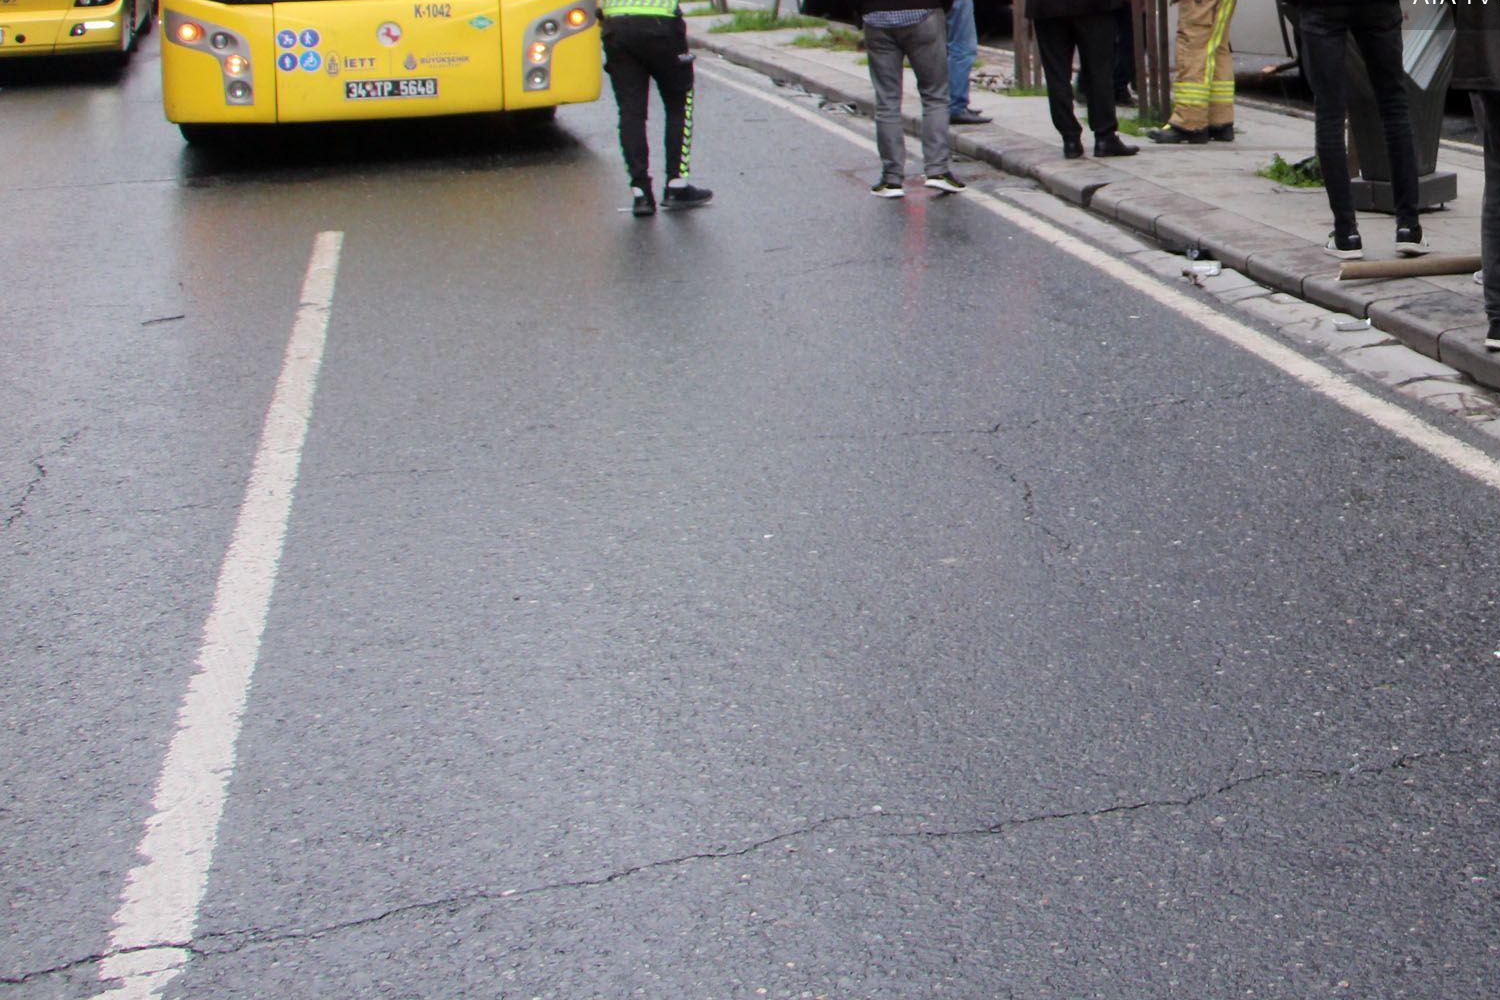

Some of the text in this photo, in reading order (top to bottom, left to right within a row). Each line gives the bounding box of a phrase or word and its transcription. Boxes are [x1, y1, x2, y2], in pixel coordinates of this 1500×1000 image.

[414, 4, 452, 18] K-1042
[343, 56, 376, 69] İETT
[348, 81, 367, 98] 34
[374, 80, 393, 97] TP
